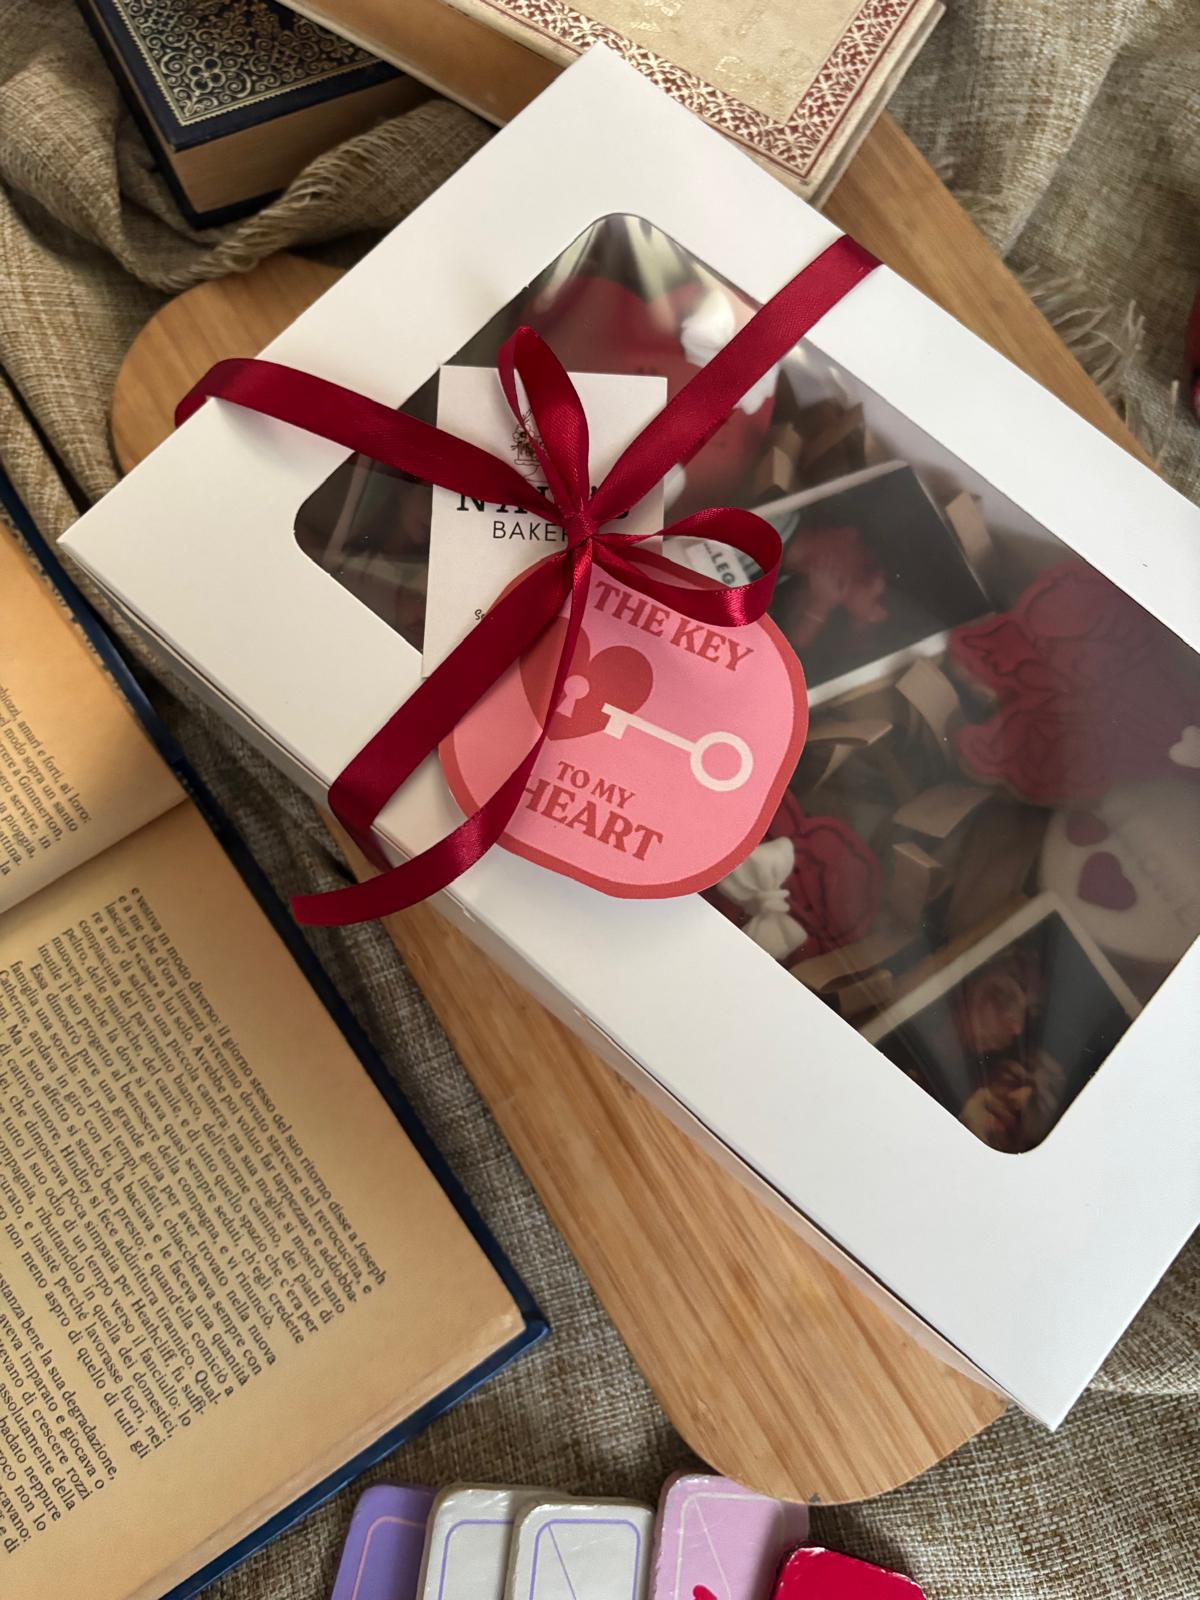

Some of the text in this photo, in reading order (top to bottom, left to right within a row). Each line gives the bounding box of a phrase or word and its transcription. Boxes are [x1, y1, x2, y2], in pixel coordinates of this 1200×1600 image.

[593, 581, 754, 672] THE KEY
[557, 760, 636, 809] TO MY
[6, 1058, 222, 1405] cattivo umore, Hindley fece addirittura tirannico. Qual-
[7, 960, 245, 1348] famiglia sorella: primi tempi, infatti, chiaccherava sempre
[9, 1095, 28, 1118] che
[24, 1120, 69, 1187] dimostrava
[60, 1187, 87, 1223] poca
[83, 1220, 120, 1275] simpatia
[113, 1274, 135, 1298] per
[130, 1297, 178, 1368] Heathcliff,
[29, 963, 276, 1366] Essa dimostrò pure grande gioia aver trovato nella nuova
[29, 1025, 66, 1073] andava
[63, 1090, 90, 1117] giro
[122, 1180, 159, 1232] baciava
[169, 1259, 198, 1303] faceva
[210, 1329, 251, 1387] quantità
[37, 943, 70, 981] inutile
[76, 1016, 115, 1068] progetto
[121, 1080, 168, 1142] benessere
[158, 1139, 187, 1175] della
[235, 1271, 275, 1329] rinunciò.
[41, 1080, 71, 1123] affetto
[75, 1137, 105, 1178] stancò
[149, 1263, 194, 1331] quand'ella
[191, 1331, 229, 1384] comiciò
[77, 919, 122, 988] compiaciuta
[130, 1010, 176, 1073] pavimento
[202, 1119, 257, 1194] dell'enorme
[293, 1272, 324, 1308] piatti
[83, 987, 113, 1028] anche
[115, 1041, 144, 1074] dove
[143, 1089, 167, 1122] stava
[162, 1123, 191, 1158] quasi
[184, 1157, 217, 1204] sempre
[240, 1247, 274, 1291] ch'egli
[268, 1292, 305, 1344] credette
[85, 961, 114, 994] delle
[195, 1142, 219, 1173] tutto
[213, 1169, 250, 1214] quello
[238, 1213, 268, 1254] spazio
[280, 1277, 304, 1311] c'era
[104, 901, 136, 938] lasciar
[192, 1041, 233, 1094] Avrebbe
[236, 1111, 271, 1154] voluto
[271, 1172, 317, 1238] tappezzare
[319, 1246, 359, 1302] addobba-
[128, 969, 163, 1013] salotto
[165, 1034, 205, 1083] piccola
[254, 1177, 293, 1221] moglie
[291, 1234, 325, 1279] mostrò
[320, 1279, 346, 1314] tanto
[155, 952, 369, 1285] d'ora innanzi avremmo dovuto starcene retrocucina,
[166, 945, 192, 980] modo
[221, 1037, 254, 1078] giorno
[249, 1077, 277, 1113] stesso
[300, 1156, 332, 1201] ritorno
[328, 1201, 353, 1232] disse
[2, 1116, 182, 1410] tutto suo odio tempo verso fanciullo:
[5, 1223, 24, 1249] non
[21, 1251, 47, 1289] meno
[44, 1291, 70, 1327] aspro
[76, 1347, 107, 1390] quello
[114, 1408, 138, 1437] tutti
[130, 1439, 152, 1459] gli
[21, 1316, 118, 1480] bene sua degradazione,
[35, 1206, 179, 1438] ributtandolo quella dei domestici,
[85, 1321, 124, 1384] lavorasse
[120, 1384, 149, 1424] fuori,
[144, 1425, 166, 1449] nei
[14, 1485, 35, 1513] non
[19, 1351, 59, 1412] imparato
[59, 1426, 97, 1478] giocava
[23, 1465, 61, 1522] neppure
[32, 1409, 93, 1500] crescere rozzi
[51, 1476, 76, 1511] della
